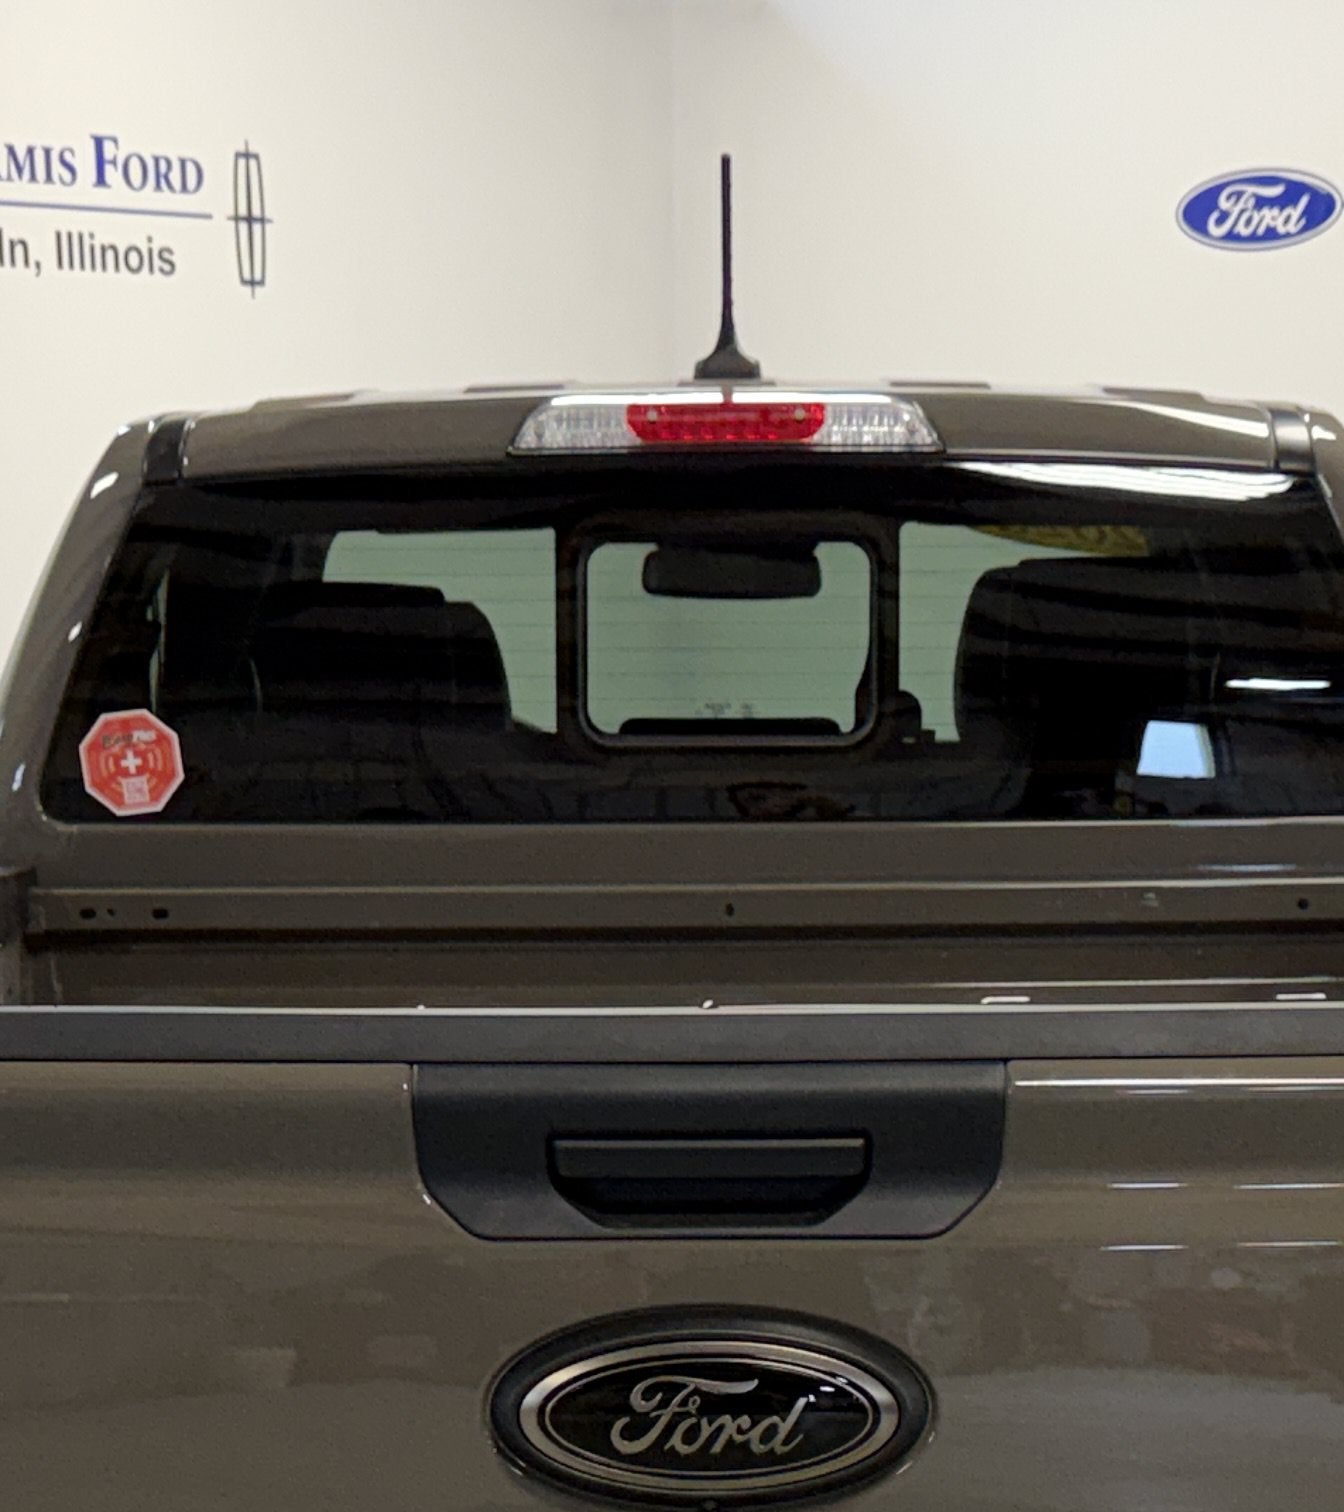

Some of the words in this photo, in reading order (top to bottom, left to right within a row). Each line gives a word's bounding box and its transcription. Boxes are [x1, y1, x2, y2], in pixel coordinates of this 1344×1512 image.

[1206, 182, 1308, 238] Ford
[55, 230, 176, 276] Illinois
[610, 1375, 809, 1455] Ford
